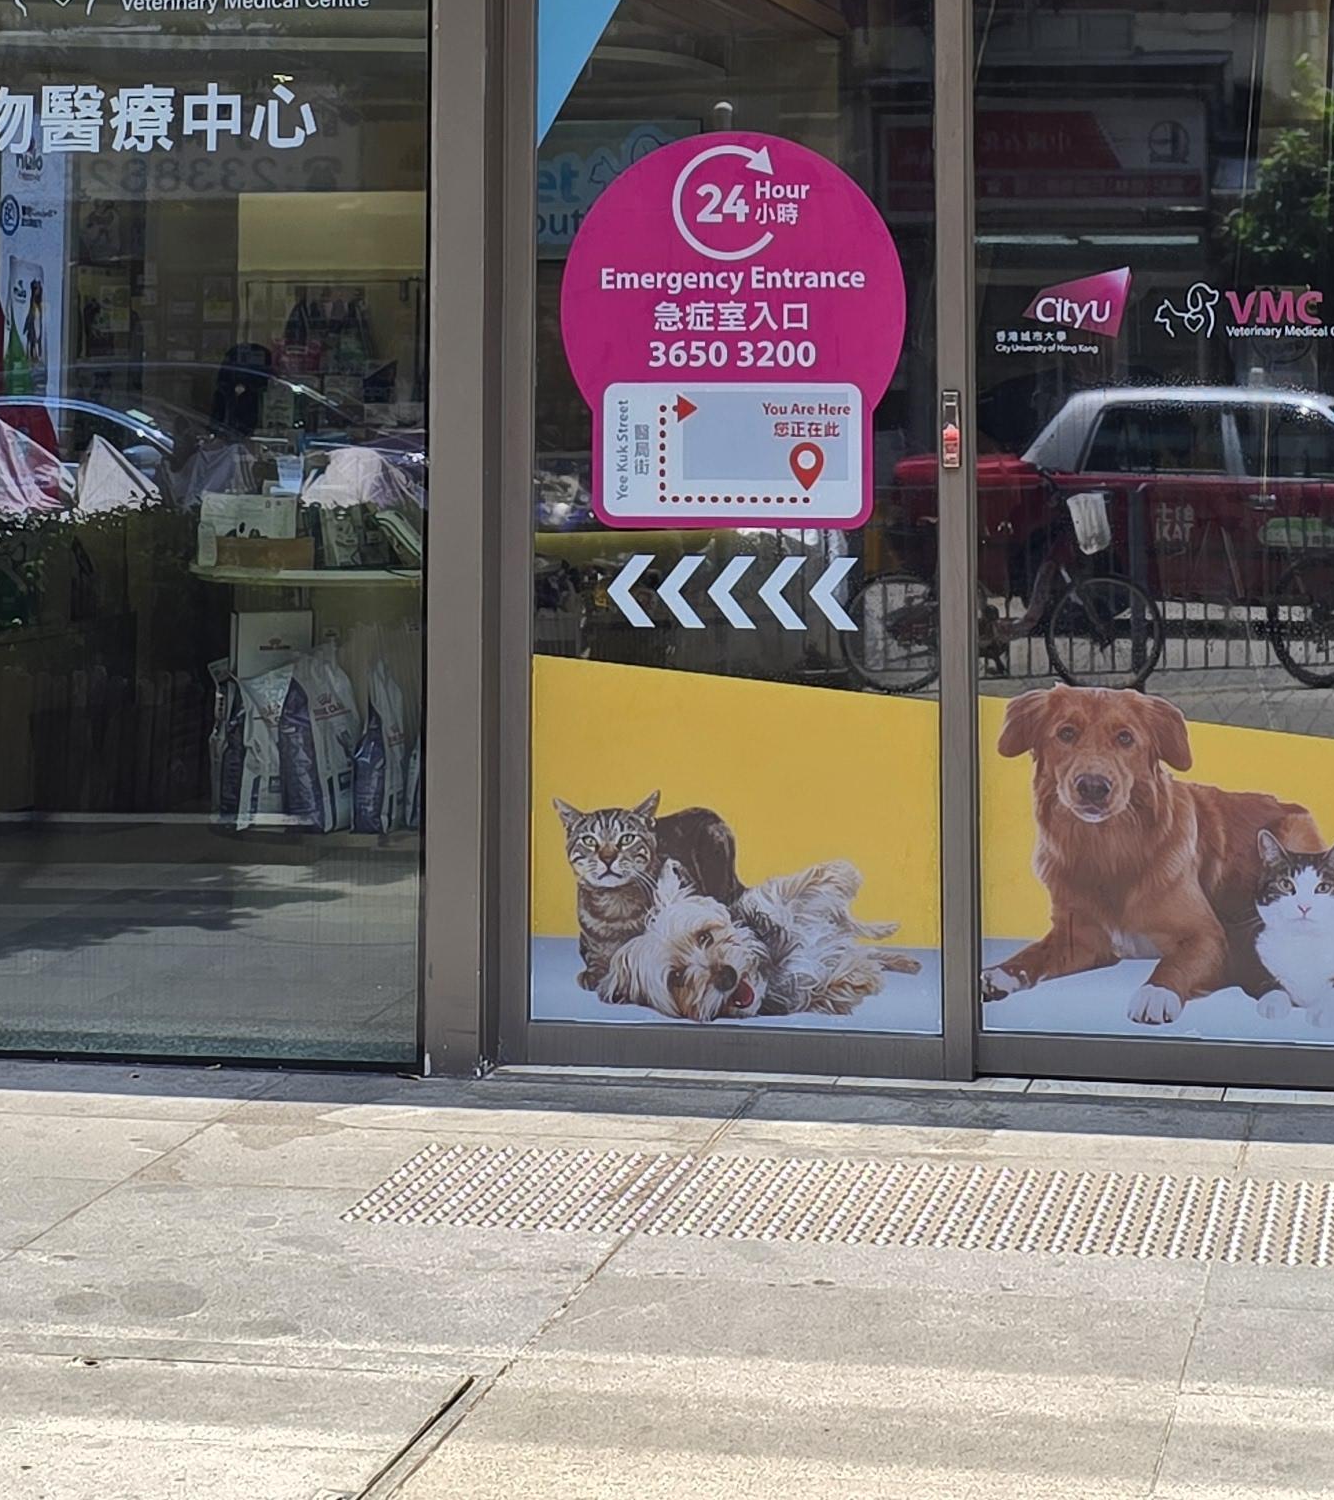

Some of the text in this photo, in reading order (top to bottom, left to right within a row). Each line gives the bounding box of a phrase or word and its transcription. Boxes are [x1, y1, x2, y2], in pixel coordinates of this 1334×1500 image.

[695, 181, 811, 223] 24 Hour
[754, 203, 798, 225] 小時
[601, 266, 866, 295] Emergency Entrance
[654, 300, 809, 332] 急症室入口
[1035, 297, 1111, 329] CityU
[1224, 290, 1324, 325] VMC
[995, 330, 1067, 343] 香港城市大學
[1225, 324, 1281, 339] Veterinary
[1284, 325, 1328, 337] Medical
[648, 340, 816, 368] 3650 3200
[995, 343, 1100, 354] City University of Hong Kong
[762, 402, 851, 416] You Are Here
[773, 421, 841, 439] 您正在此
[616, 399, 629, 501] Yee Kuk Street
